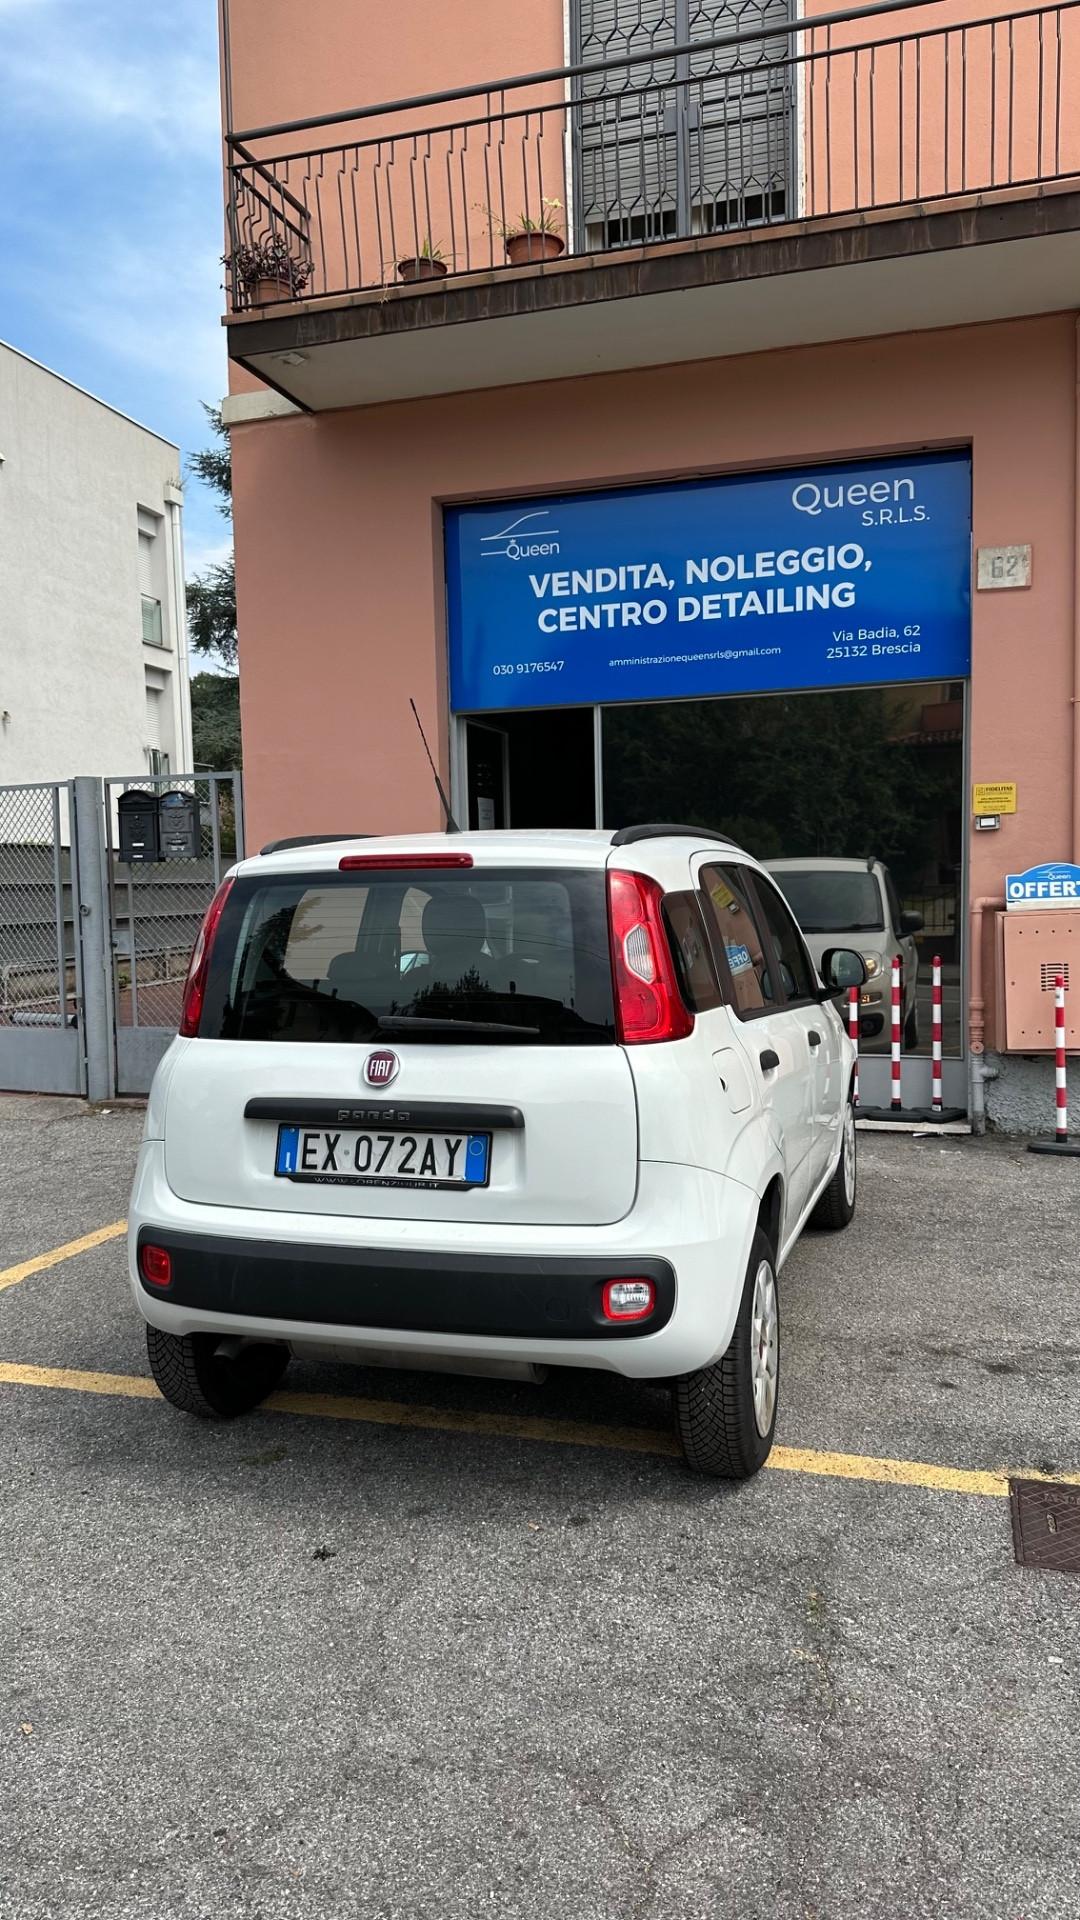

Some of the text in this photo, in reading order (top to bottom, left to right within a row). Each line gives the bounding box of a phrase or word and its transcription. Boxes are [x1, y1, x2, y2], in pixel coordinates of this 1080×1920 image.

[791, 478, 915, 516] Queen
[861, 505, 931, 527] S.R.L.S.
[506, 541, 560, 561] Queen
[528, 543, 873, 598] VENDITA, NOLEGGIO,
[537, 582, 856, 634] CENTRO DETAILING
[832, 624, 921, 642] Via Badia, 62
[608, 646, 782, 668] amministrazionequeensrls@gmail.com
[826, 641, 921, 659] 25132 Brescia
[493, 660, 565, 676] 030 9176547
[1047, 872, 1072, 881] Queen
[369, 1059, 393, 1077] FIAT
[301, 1133, 463, 1177] EX 072AY
